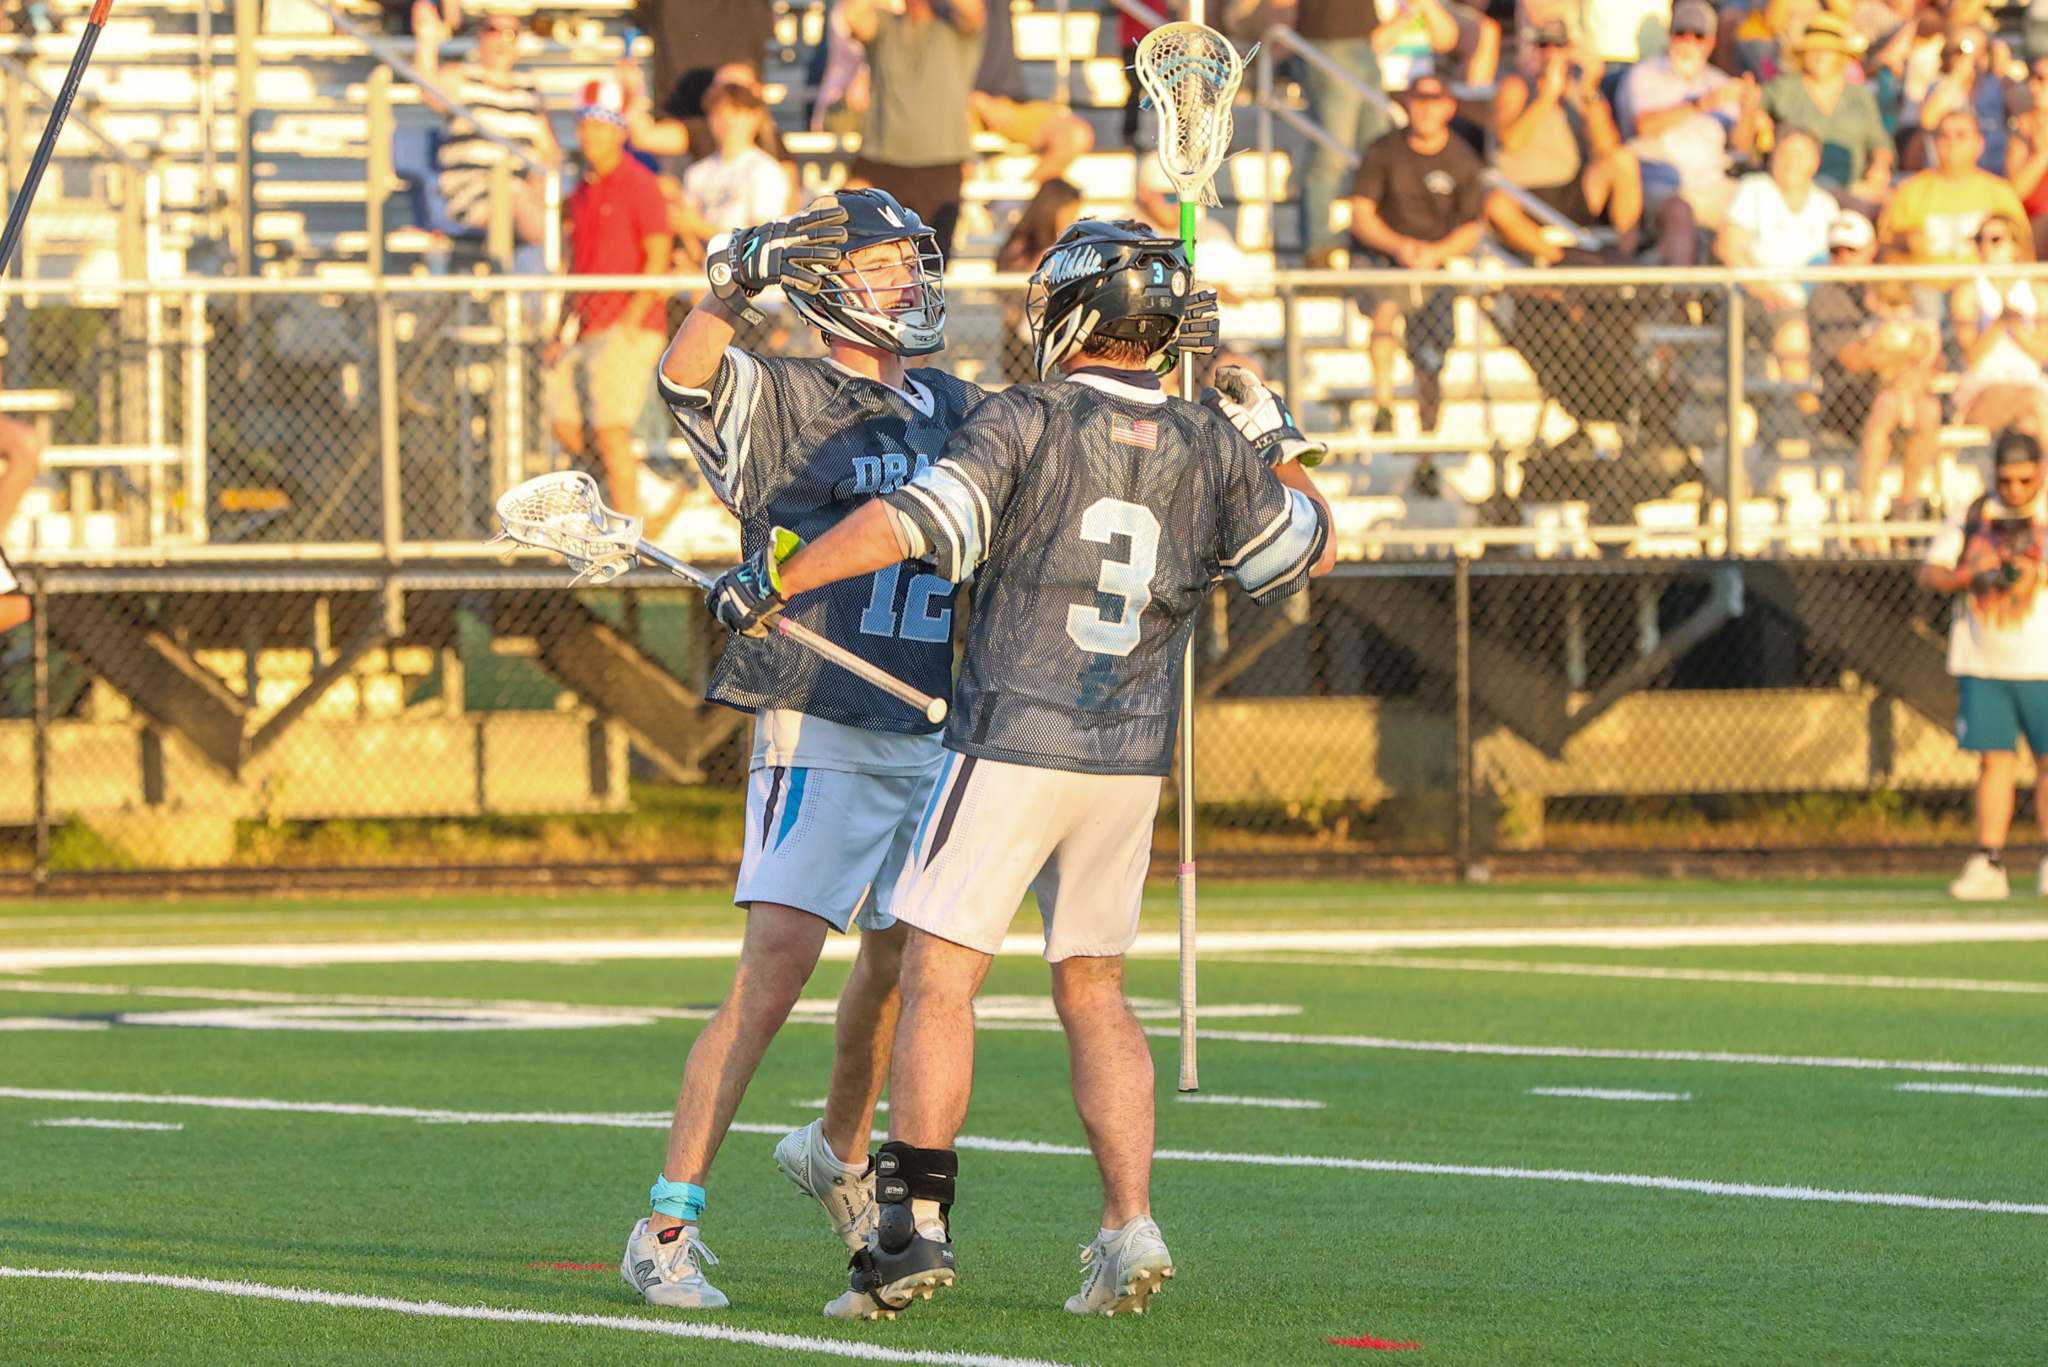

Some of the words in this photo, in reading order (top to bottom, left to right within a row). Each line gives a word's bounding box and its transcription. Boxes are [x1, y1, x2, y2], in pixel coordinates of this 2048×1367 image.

[1153, 262, 1163, 284] 3
[852, 453, 936, 494] DRA
[860, 562, 955, 643] 12
[1065, 497, 1161, 657] 3
